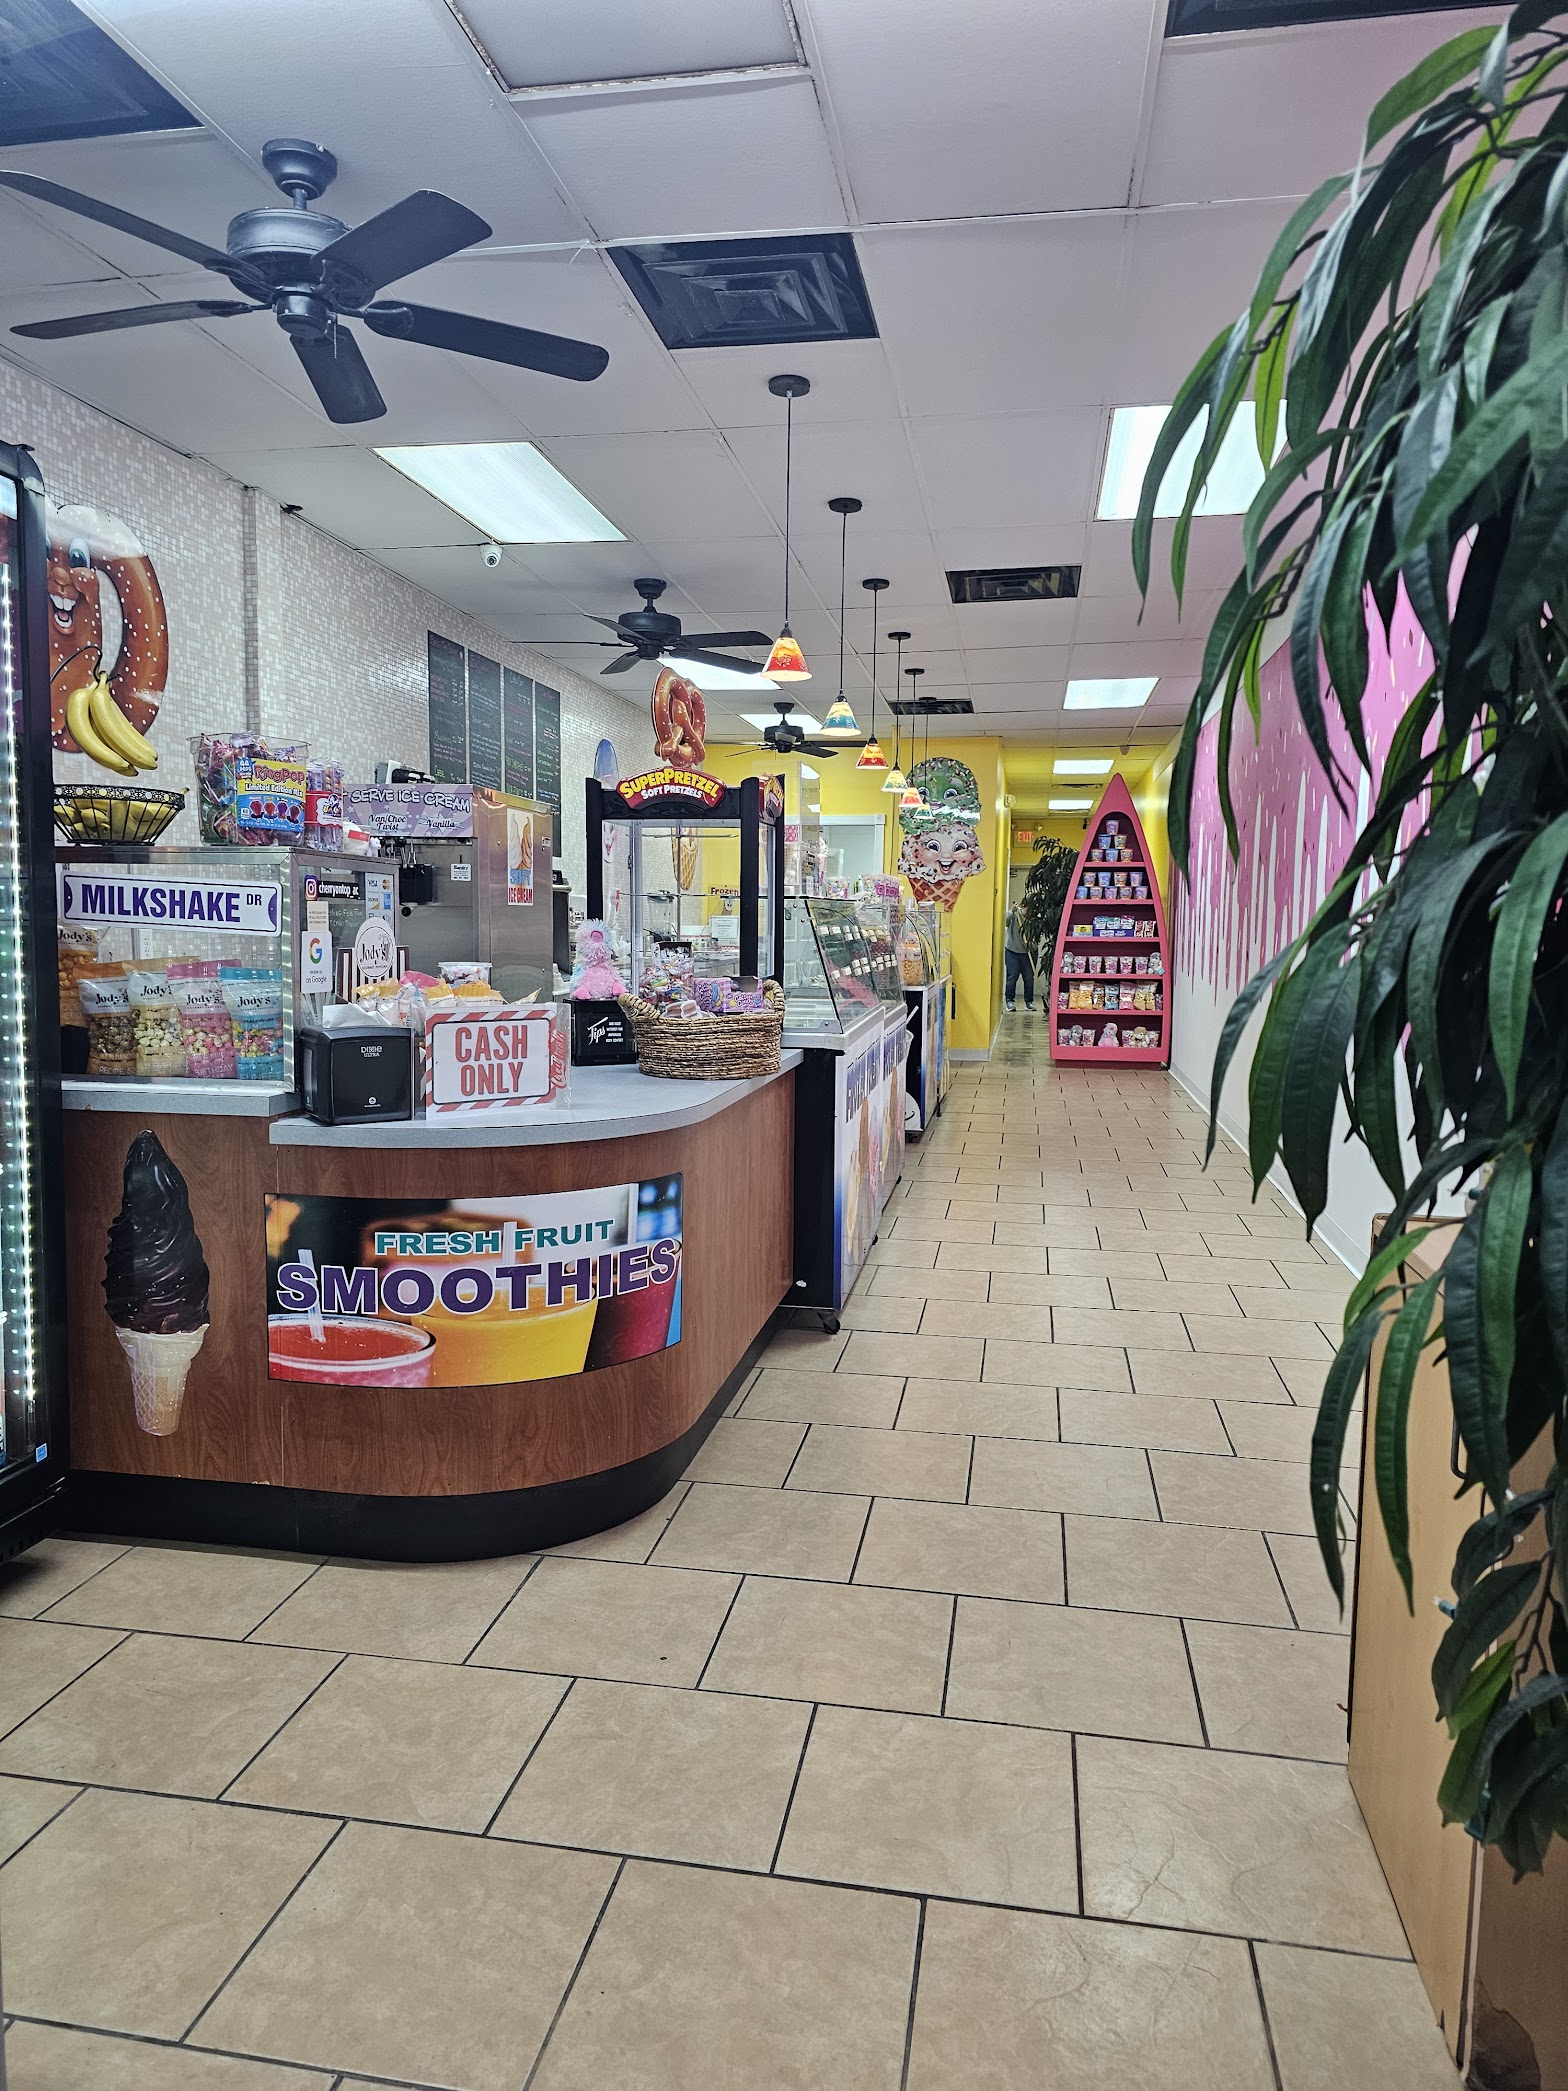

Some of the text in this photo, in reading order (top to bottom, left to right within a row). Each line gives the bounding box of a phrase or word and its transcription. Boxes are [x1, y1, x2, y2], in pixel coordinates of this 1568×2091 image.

[245, 783, 303, 798] Limited Edition Mix
[619, 768, 720, 799] SUPERPRETZEL
[640, 784, 703, 800] SOFT PRETZELS
[350, 788, 470, 813] SERVE ICE CREAM
[369, 814, 407, 826] Van/Choc
[377, 822, 399, 831] Twist
[427, 819, 455, 828] Vanilla
[1017, 831, 1033, 842] EXIT
[510, 868, 531, 885] SOFT
[711, 886, 739, 896] Frozen
[81, 883, 262, 922] MILKSHAKE DR
[58, 928, 93, 943] Jody's
[360, 943, 386, 964] Jody's
[312, 975, 327, 984] Google
[95, 993, 129, 1005] Jody's
[186, 994, 220, 1006] Jody's
[237, 995, 271, 1008] Jody's
[587, 1016, 609, 1046] Tips
[454, 1024, 528, 1063] CASH
[99, 1065, 125, 1075] RECIPE
[194, 1063, 233, 1076] BIRTHDAY
[460, 1061, 524, 1097] ONLY
[374, 1218, 615, 1256] FRESH FRUIT
[275, 1237, 679, 1317] SMOOTHIES
